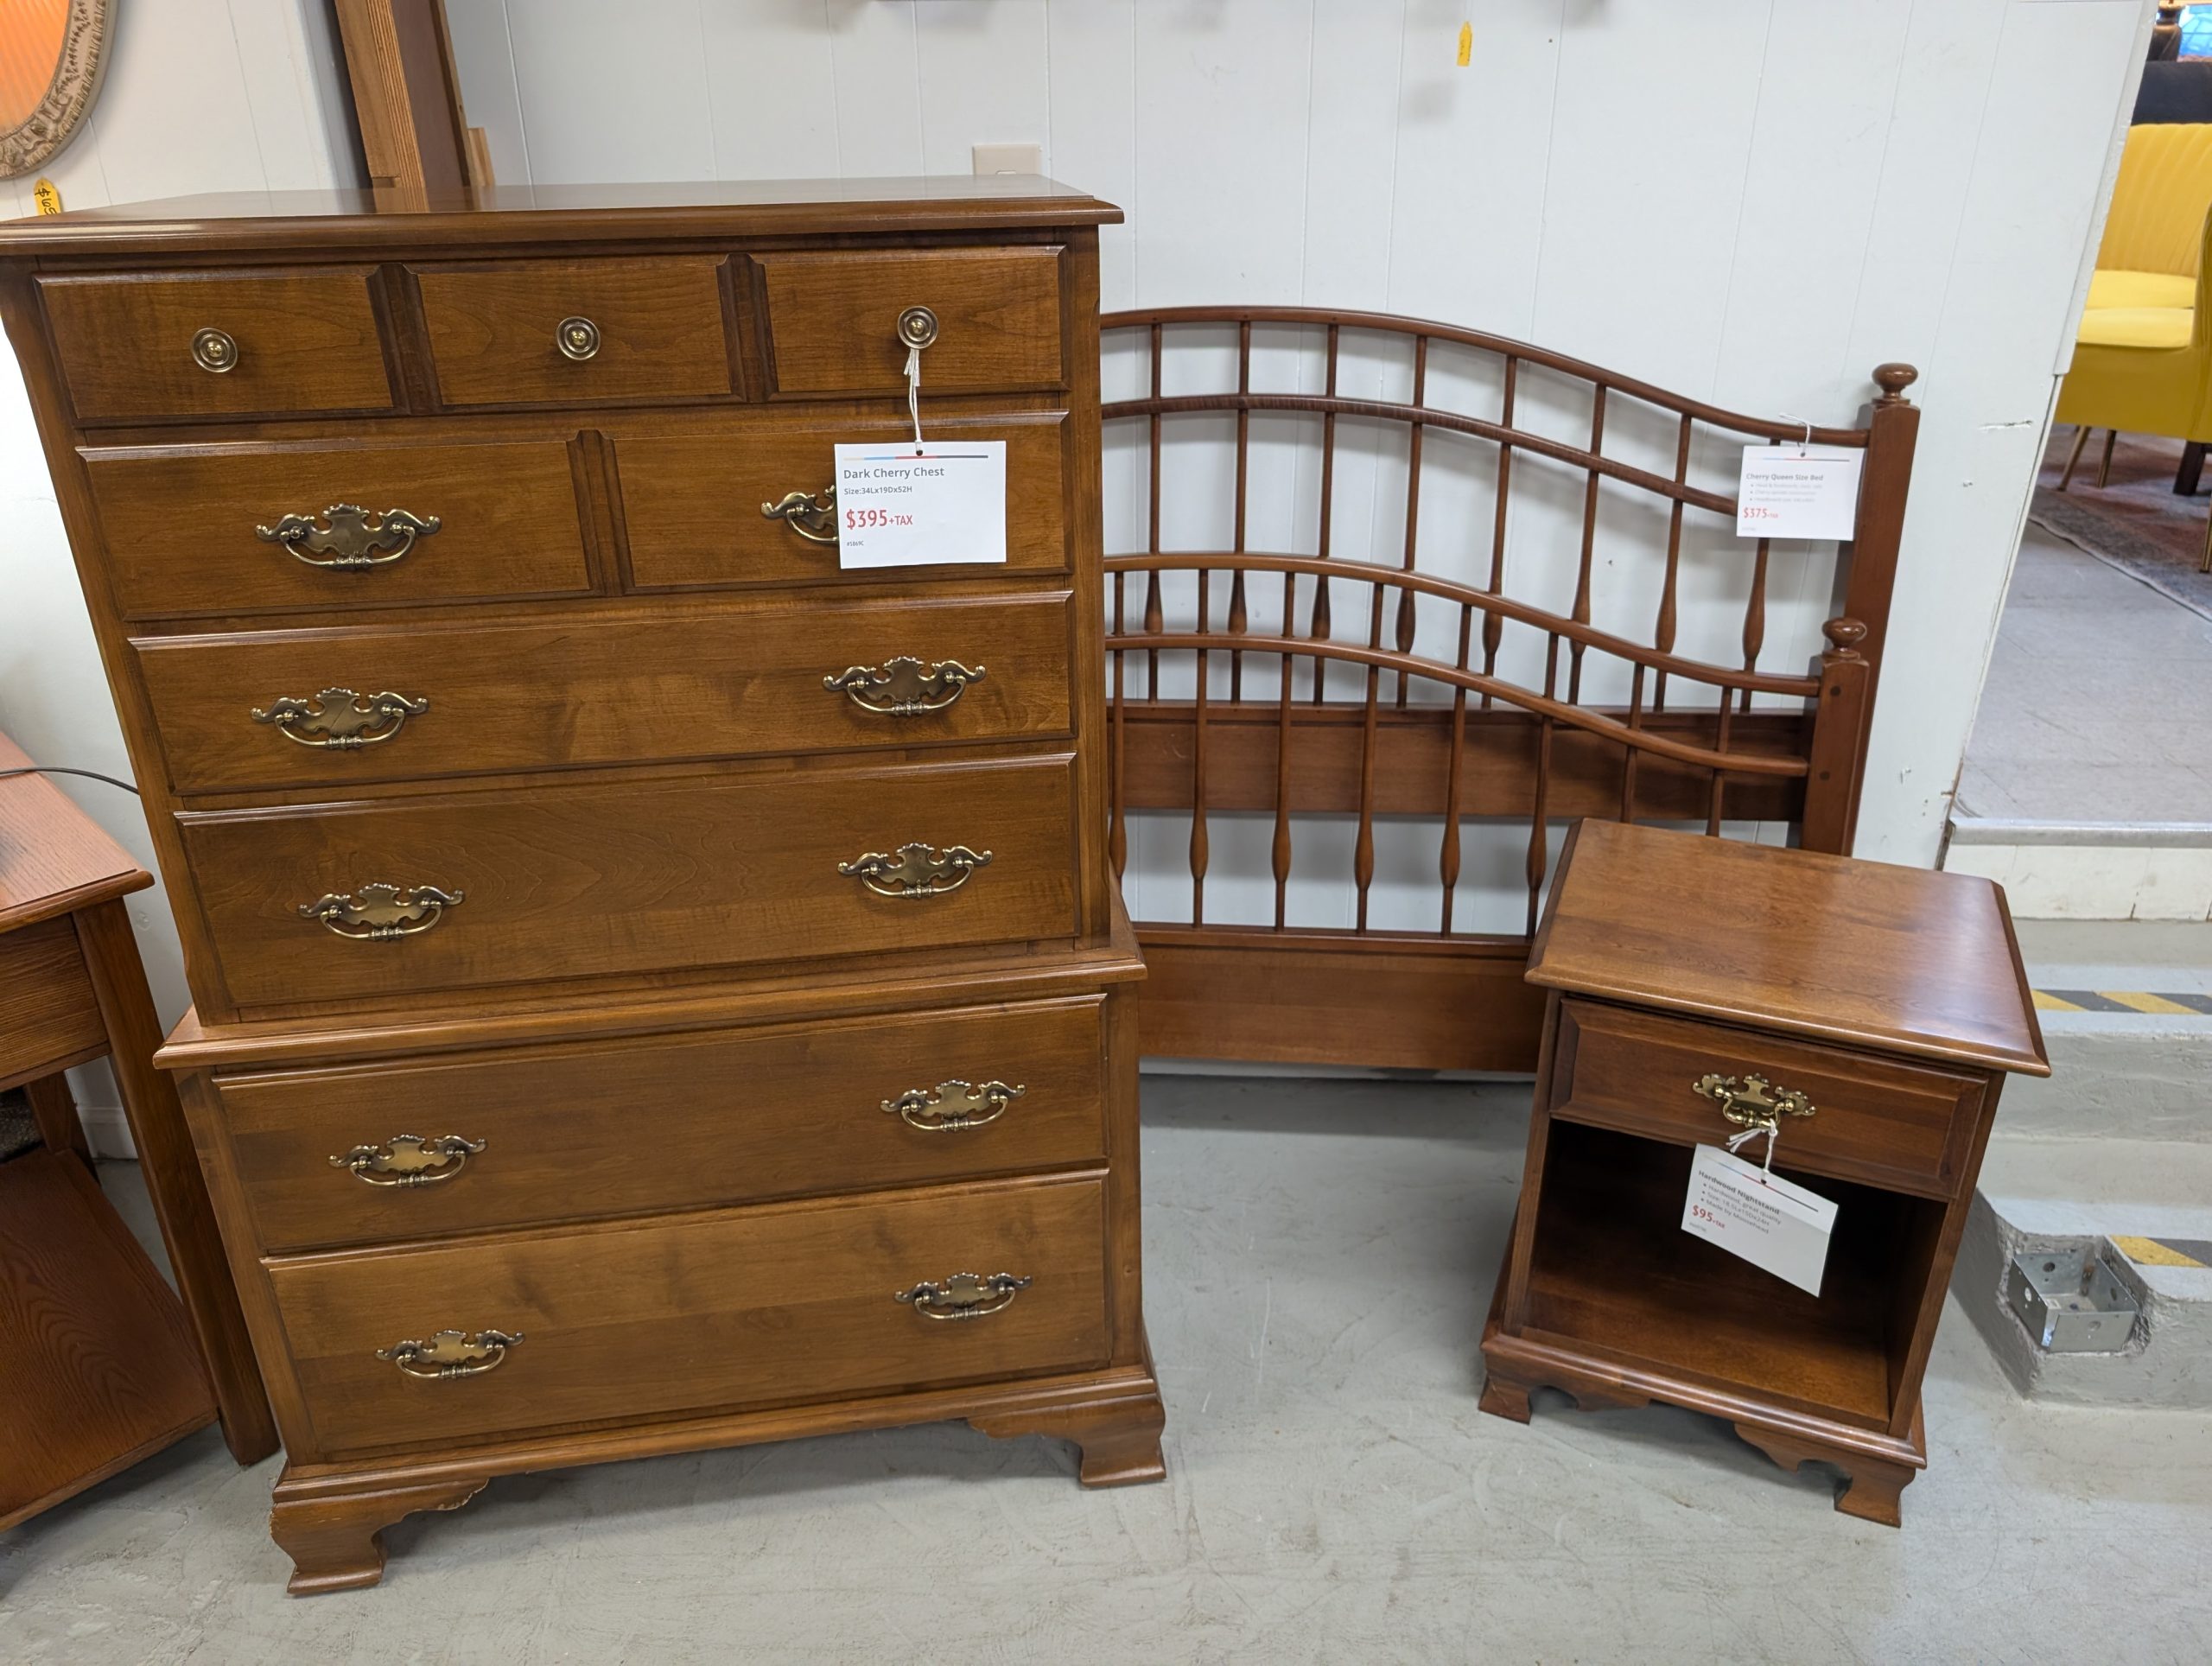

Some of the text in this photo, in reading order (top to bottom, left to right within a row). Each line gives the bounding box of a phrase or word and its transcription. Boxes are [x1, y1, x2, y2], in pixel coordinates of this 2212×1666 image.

[843, 467, 945, 480] Dark Cherry Chest
[843, 486, 912, 495] Size:34Lx19Dx52H
[1698, 1169, 1781, 1216] Hardwood Nightstand
